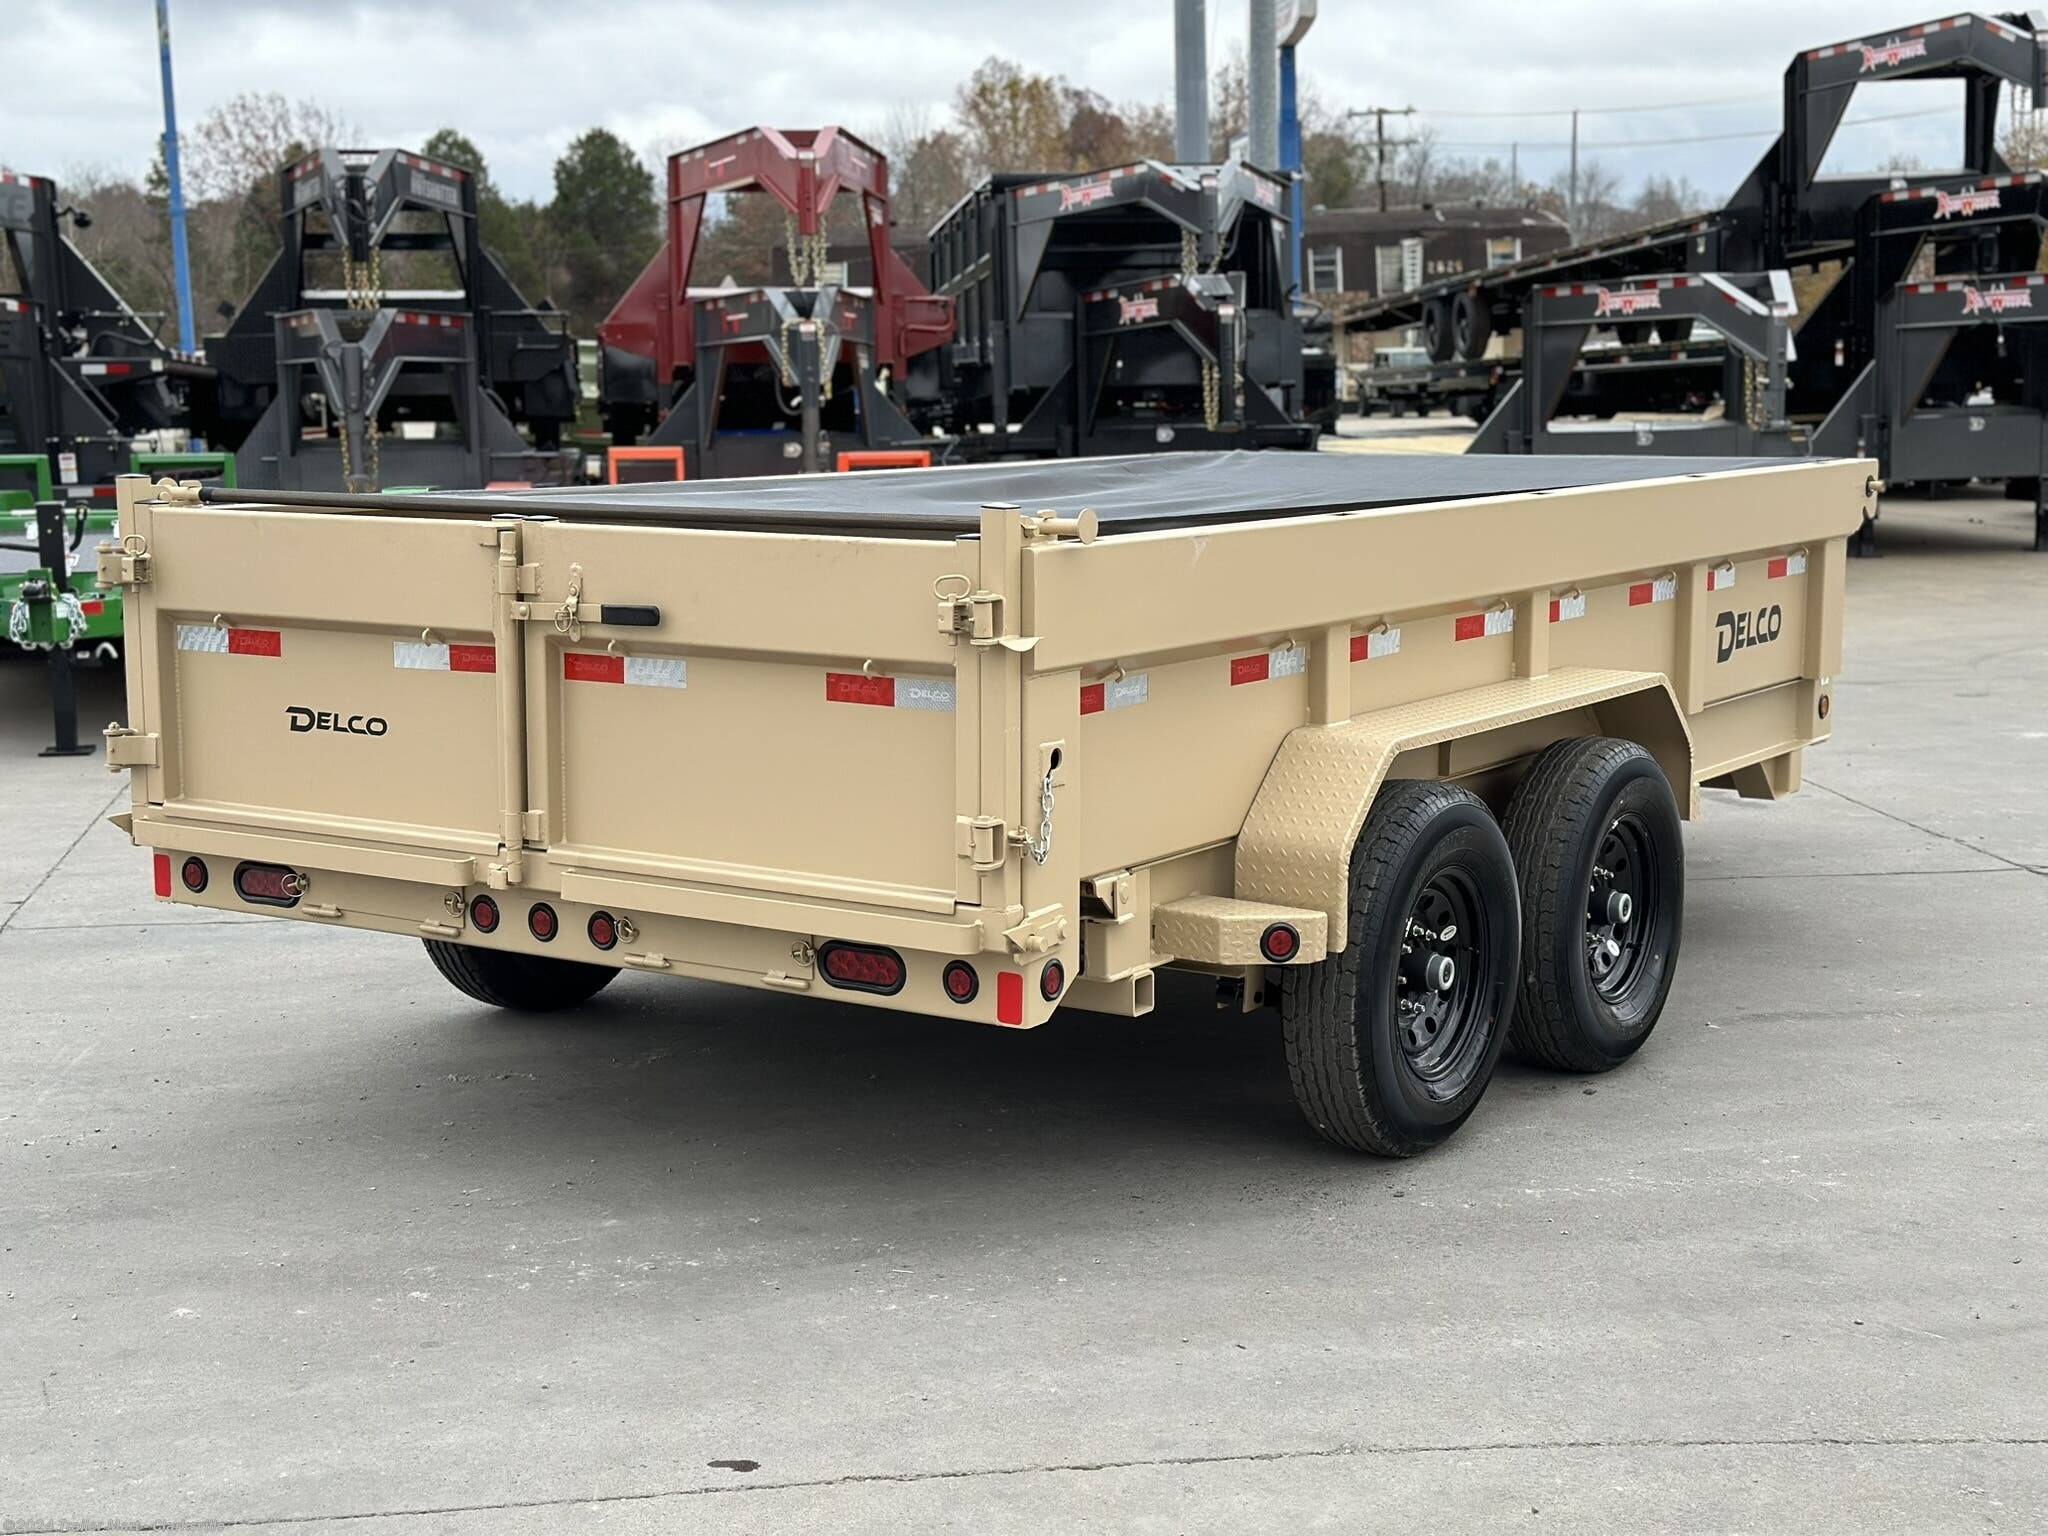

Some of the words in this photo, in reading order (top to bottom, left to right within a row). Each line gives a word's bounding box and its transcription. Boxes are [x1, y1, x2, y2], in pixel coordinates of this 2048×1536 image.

[1715, 604, 1782, 664] DELCO
[908, 687, 950, 700] DELCO
[285, 705, 388, 736] DELCO
